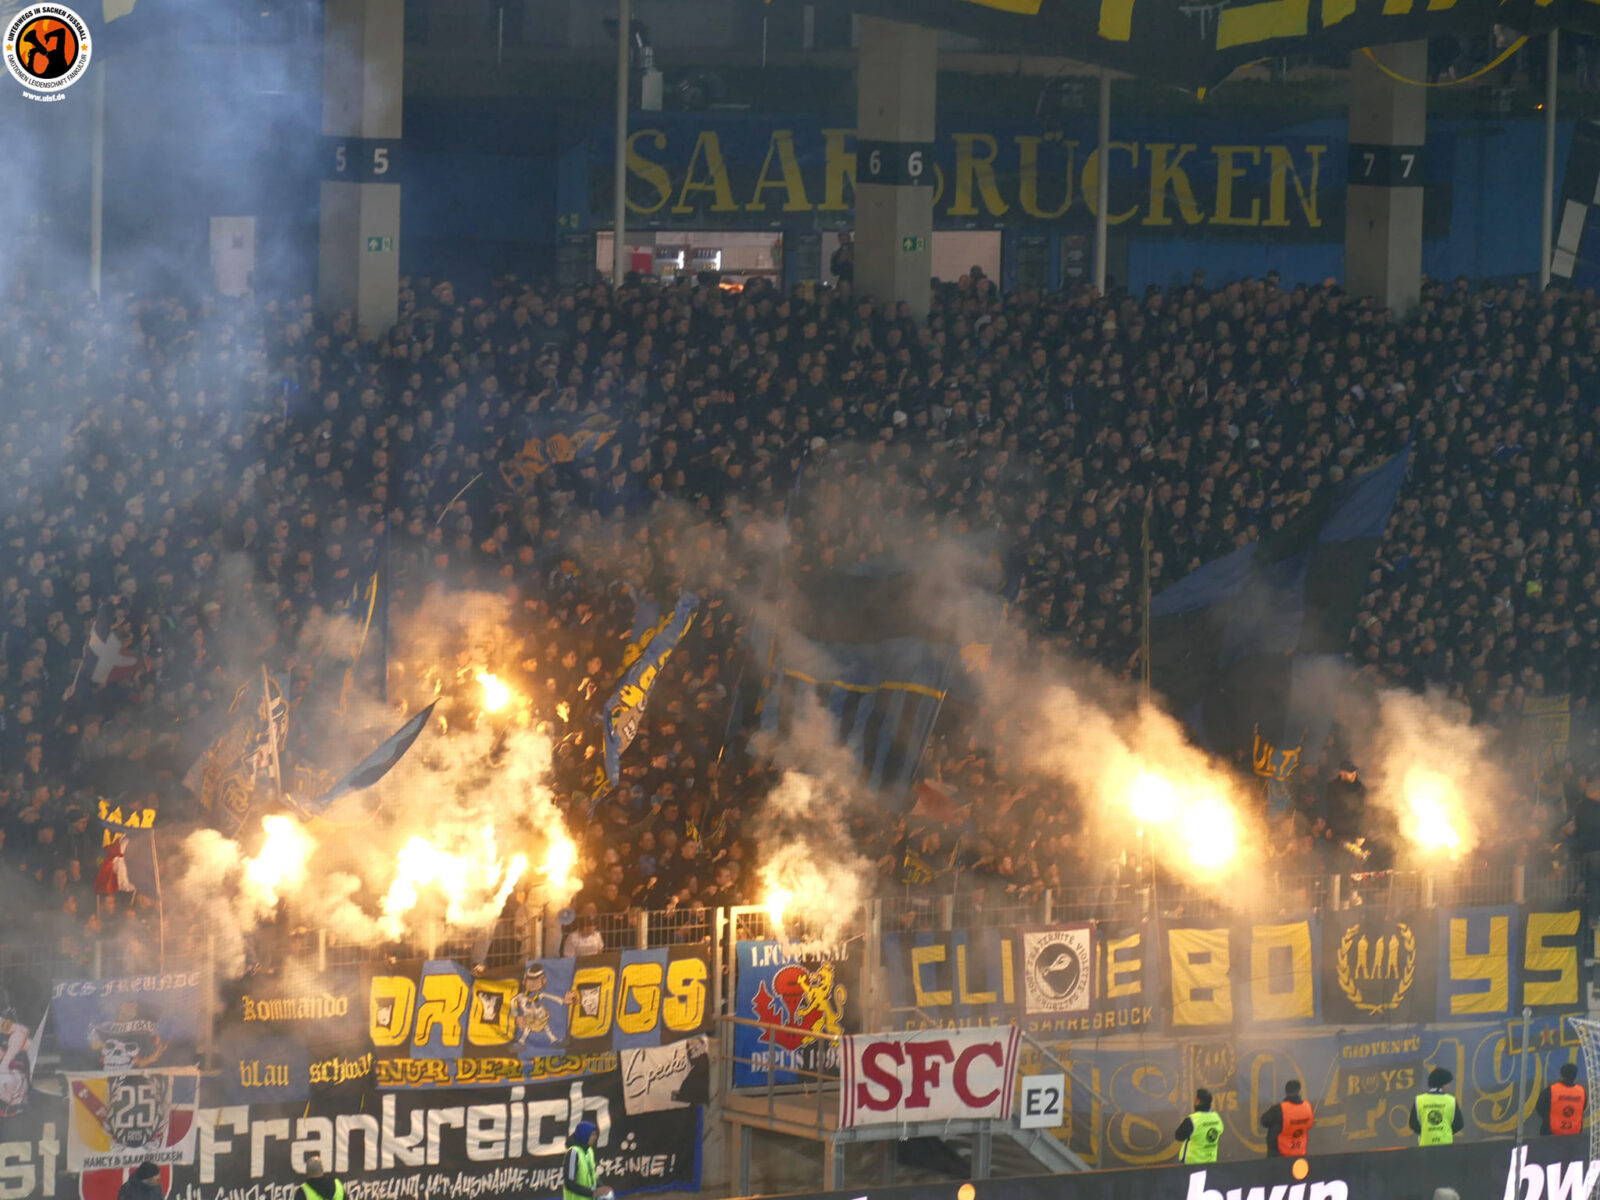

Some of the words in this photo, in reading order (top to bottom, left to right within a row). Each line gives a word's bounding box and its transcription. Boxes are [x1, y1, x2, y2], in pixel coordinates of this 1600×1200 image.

[336, 146, 347, 172] 5
[374, 148, 389, 174] 5
[869, 149, 881, 174] 6
[907, 151, 923, 176] 6
[1363, 153, 1375, 177] 7
[1401, 154, 1415, 178] 7
[625, 128, 1326, 228] SAARRÜCKEN
[98, 800, 156, 828] SAAR
[911, 932, 1143, 1009] CLIE
[376, 1058, 452, 1087] NUR
[454, 1056, 525, 1084] DER
[857, 1040, 1004, 1111] SFC
[116, 1084, 157, 1129] 25
[1026, 1086, 1060, 1116] E2
[198, 1080, 611, 1184] Frankreich
[84, 1155, 113, 1168] NANCY
